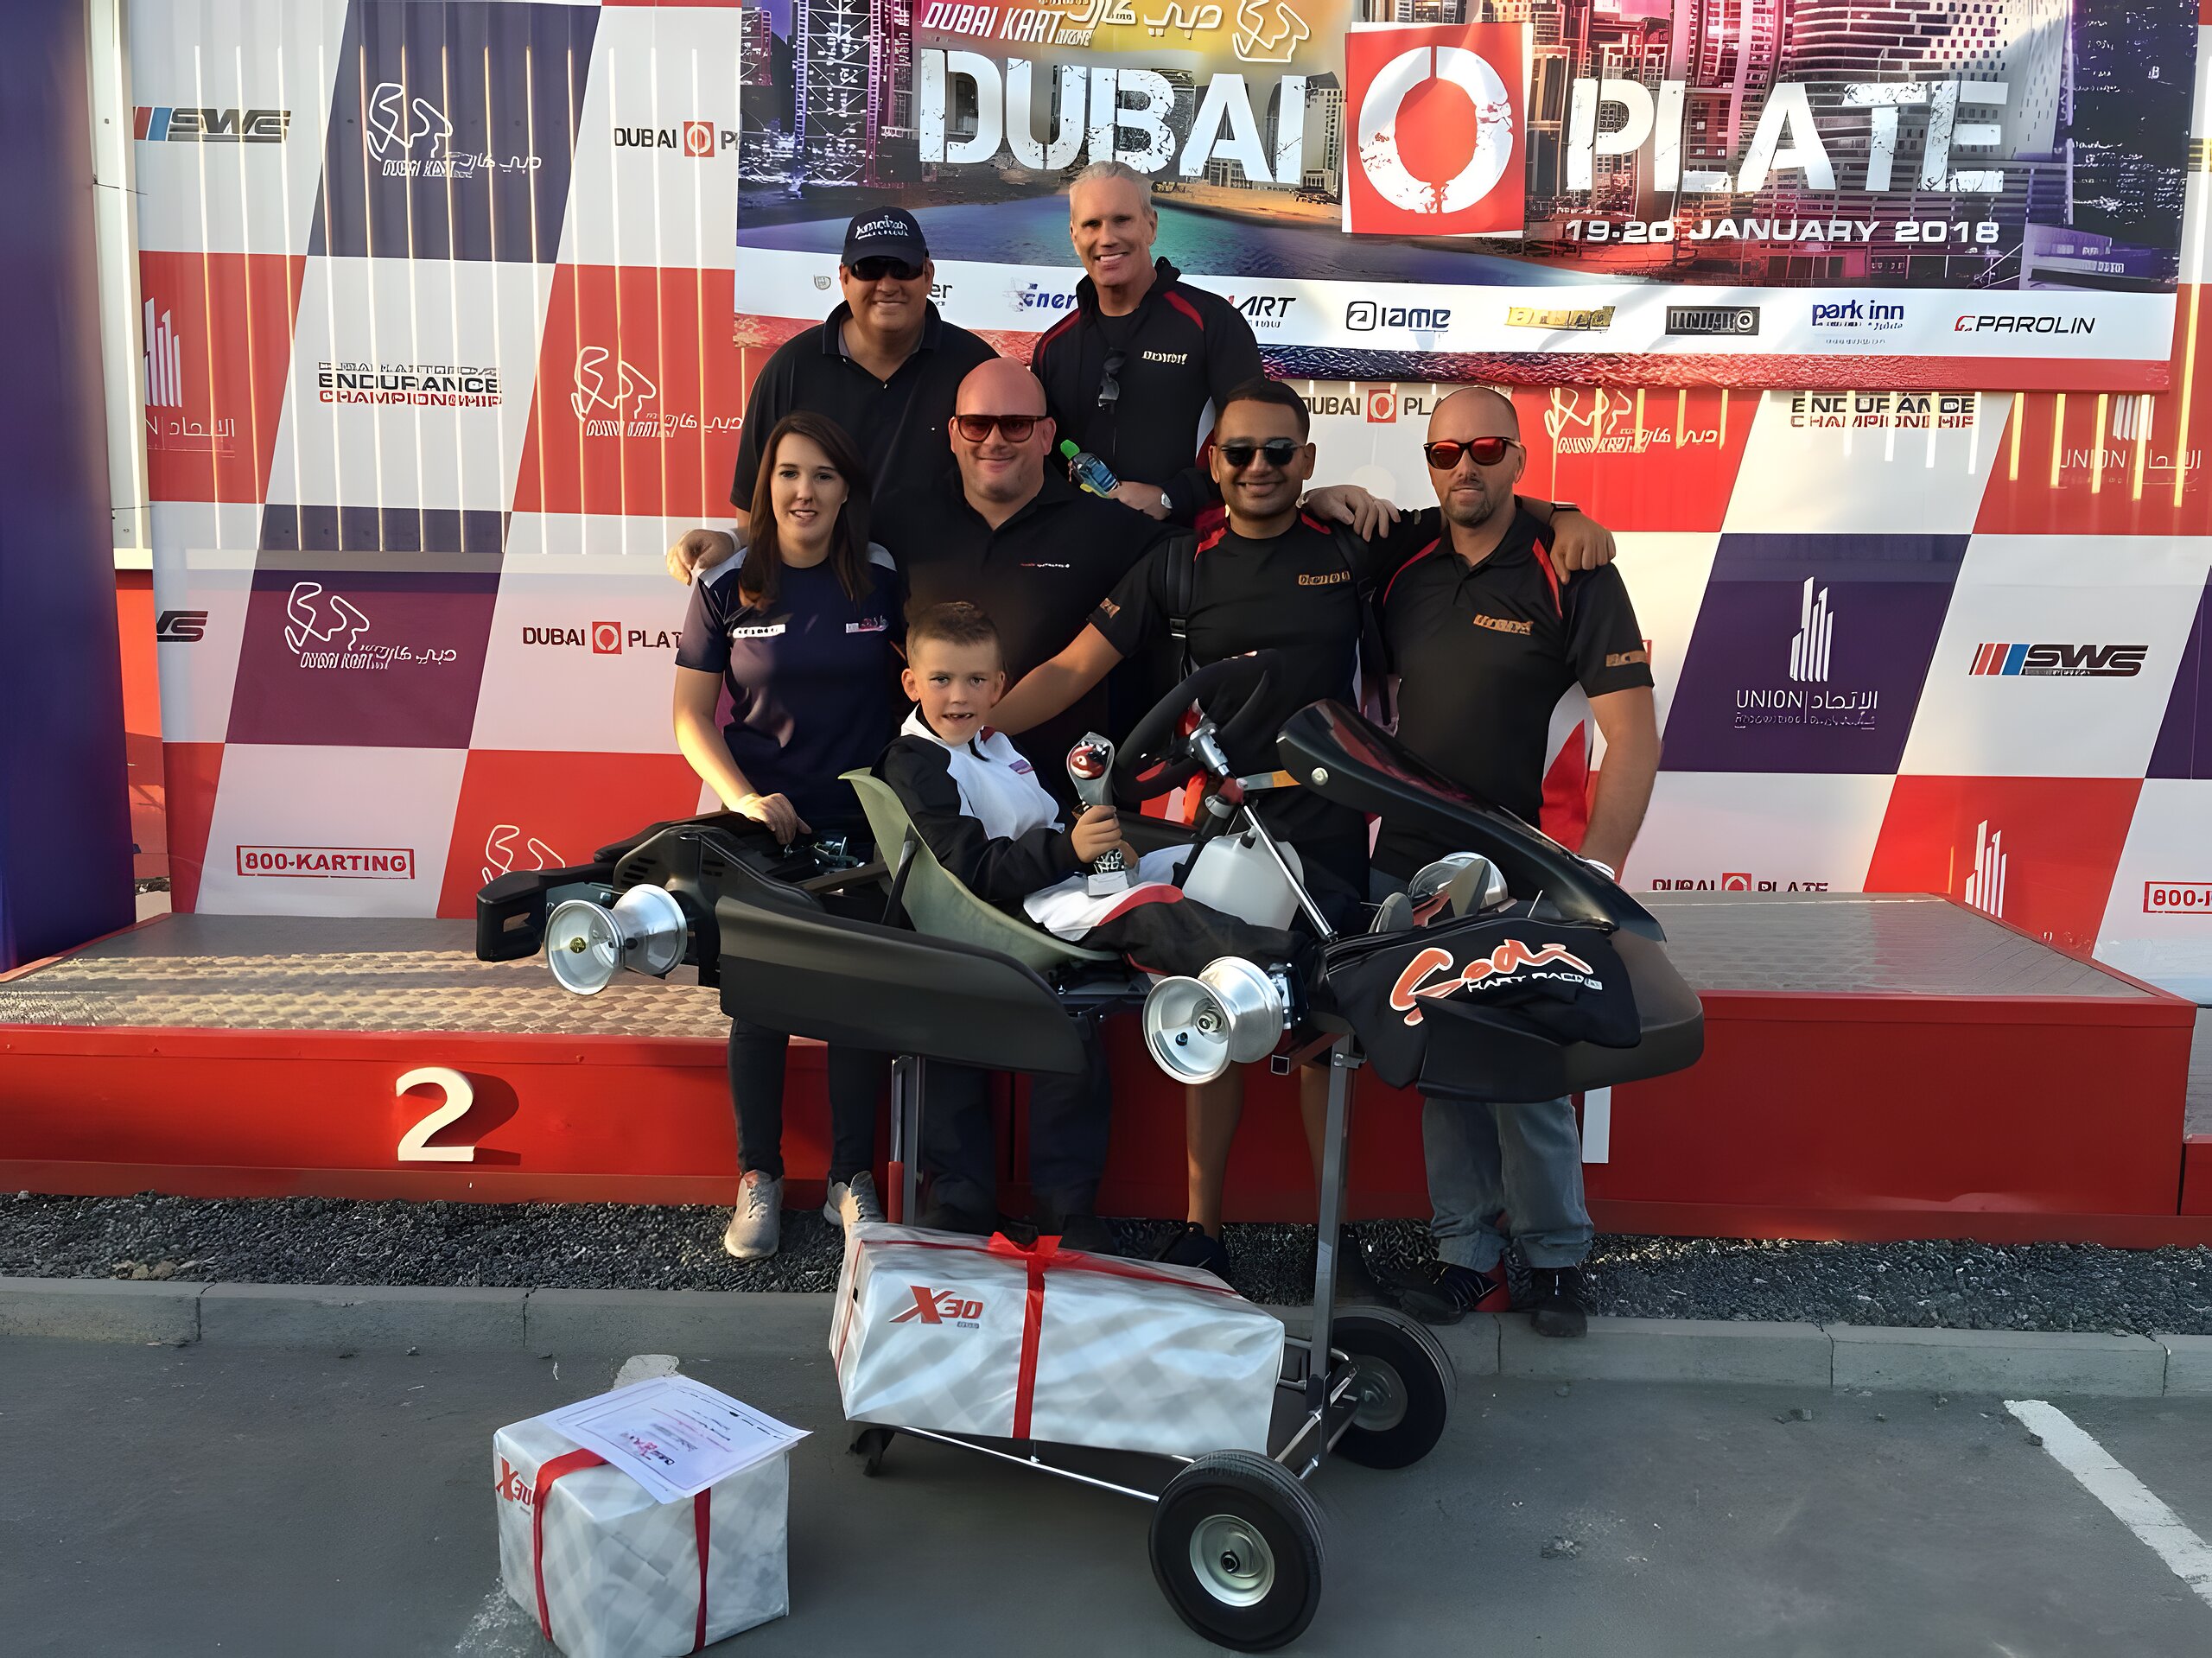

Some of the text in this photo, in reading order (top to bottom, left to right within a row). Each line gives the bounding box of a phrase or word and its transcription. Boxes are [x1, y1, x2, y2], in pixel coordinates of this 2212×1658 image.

[922, 2, 1065, 43] DUBAI KART
[1143, 1, 1223, 40] دبي
[919, 48, 1306, 184] DUBAI
[1568, 79, 2008, 193] PLATE
[614, 128, 677, 149] DUBAI
[1688, 218, 1878, 244] JANUARY
[1895, 220, 2000, 244] 2018
[1229, 295, 1296, 317] ART
[1812, 299, 1904, 326] park inn
[318, 372, 499, 393] ENDURANCE
[523, 627, 585, 645] DUBAI
[2024, 644, 2149, 677] SWS
[1737, 690, 1802, 708] UNION
[245, 852, 407, 872] 800-KARTING
[396, 1066, 476, 1162] 2
[888, 1285, 984, 1324] X30
